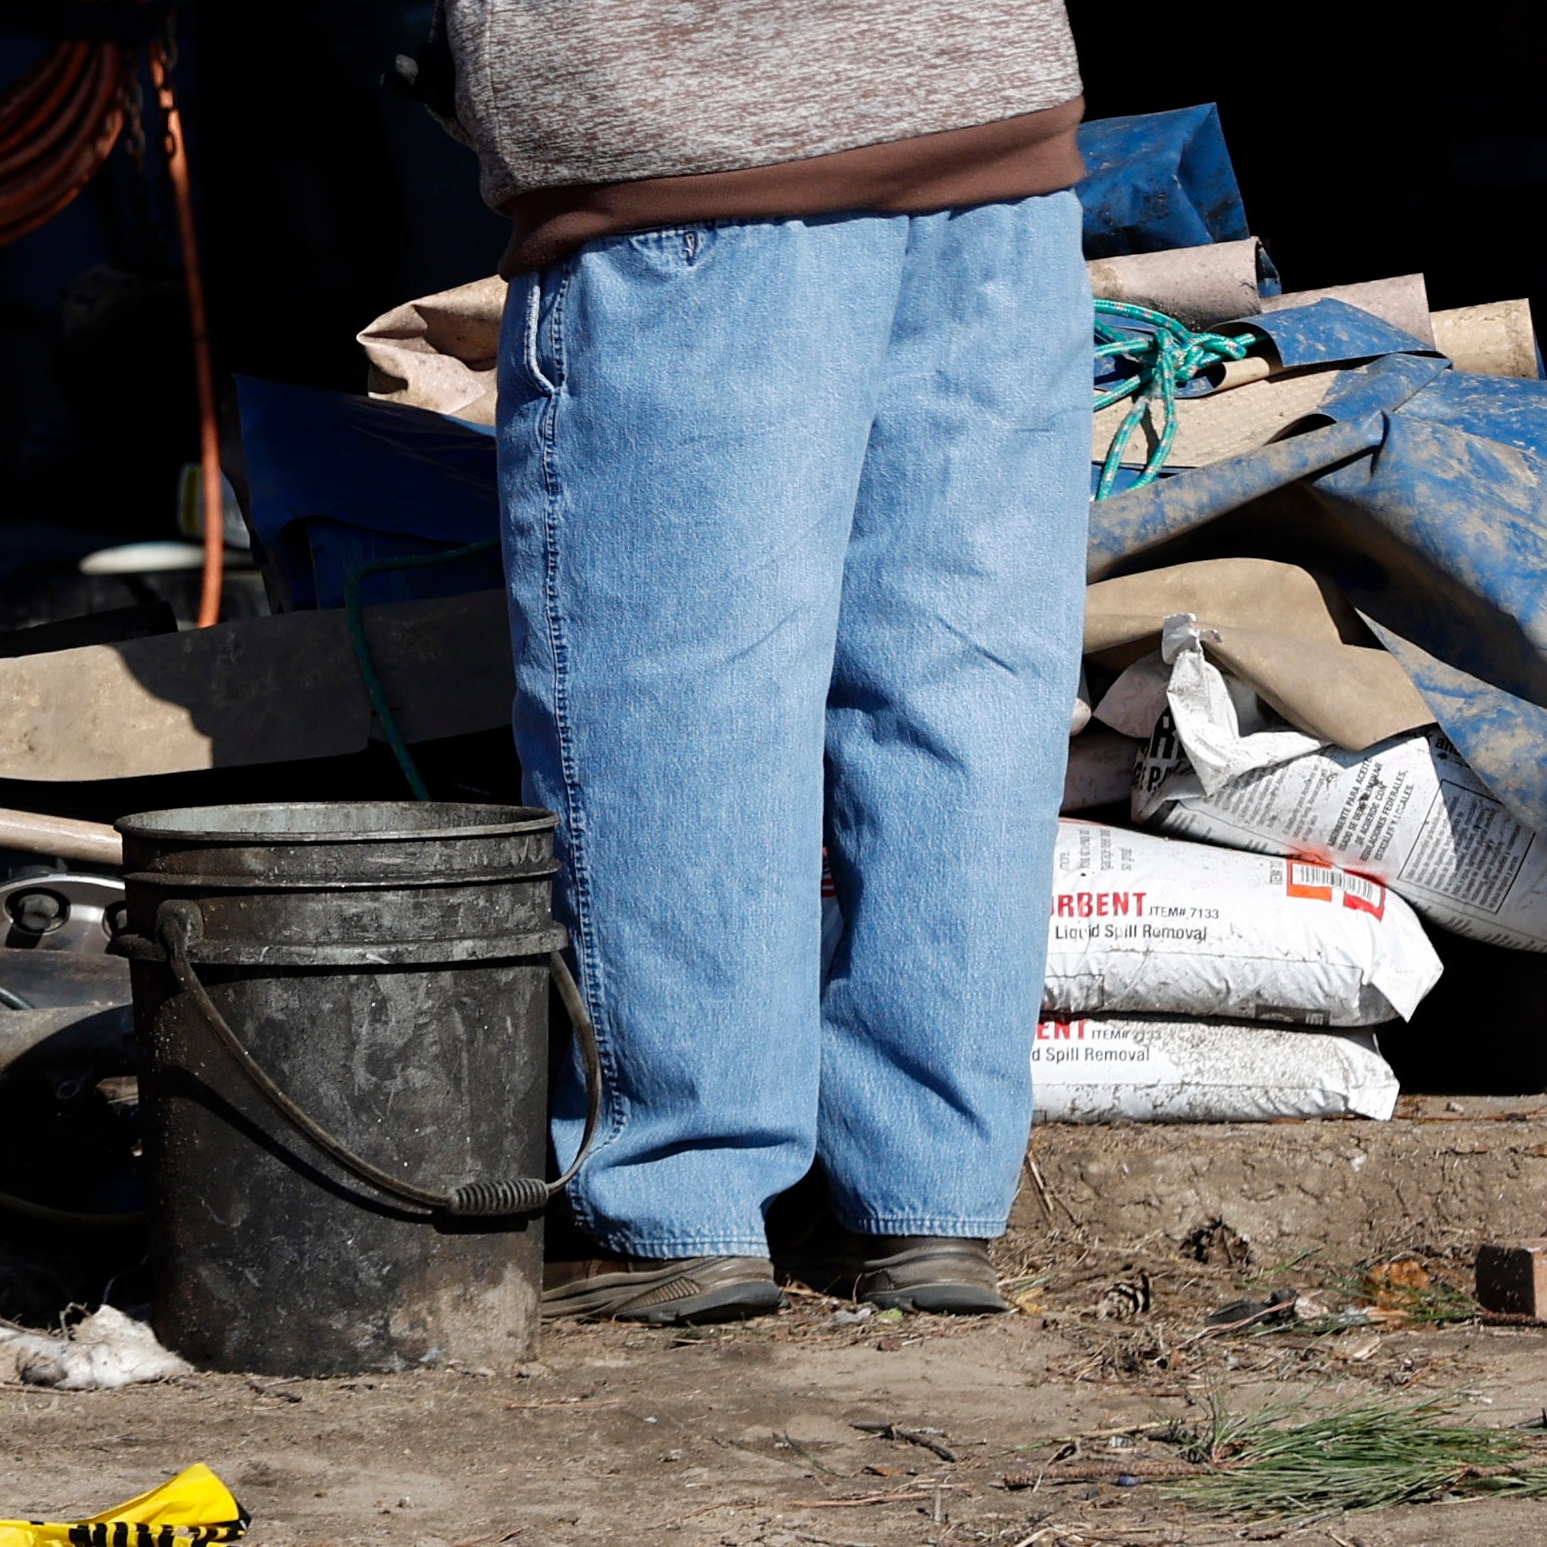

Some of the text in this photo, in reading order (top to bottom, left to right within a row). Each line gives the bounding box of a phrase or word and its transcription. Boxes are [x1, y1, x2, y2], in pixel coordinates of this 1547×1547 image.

[1346, 785, 1360, 806] PARA
[1349, 821, 1357, 830] SE
[1360, 801, 1379, 835] ACUERDO
[1050, 892, 1219, 919] RBENT ITEM# 7133
[1045, 1047, 1080, 1064] Spill
[1084, 1046, 1150, 1062] Removal
